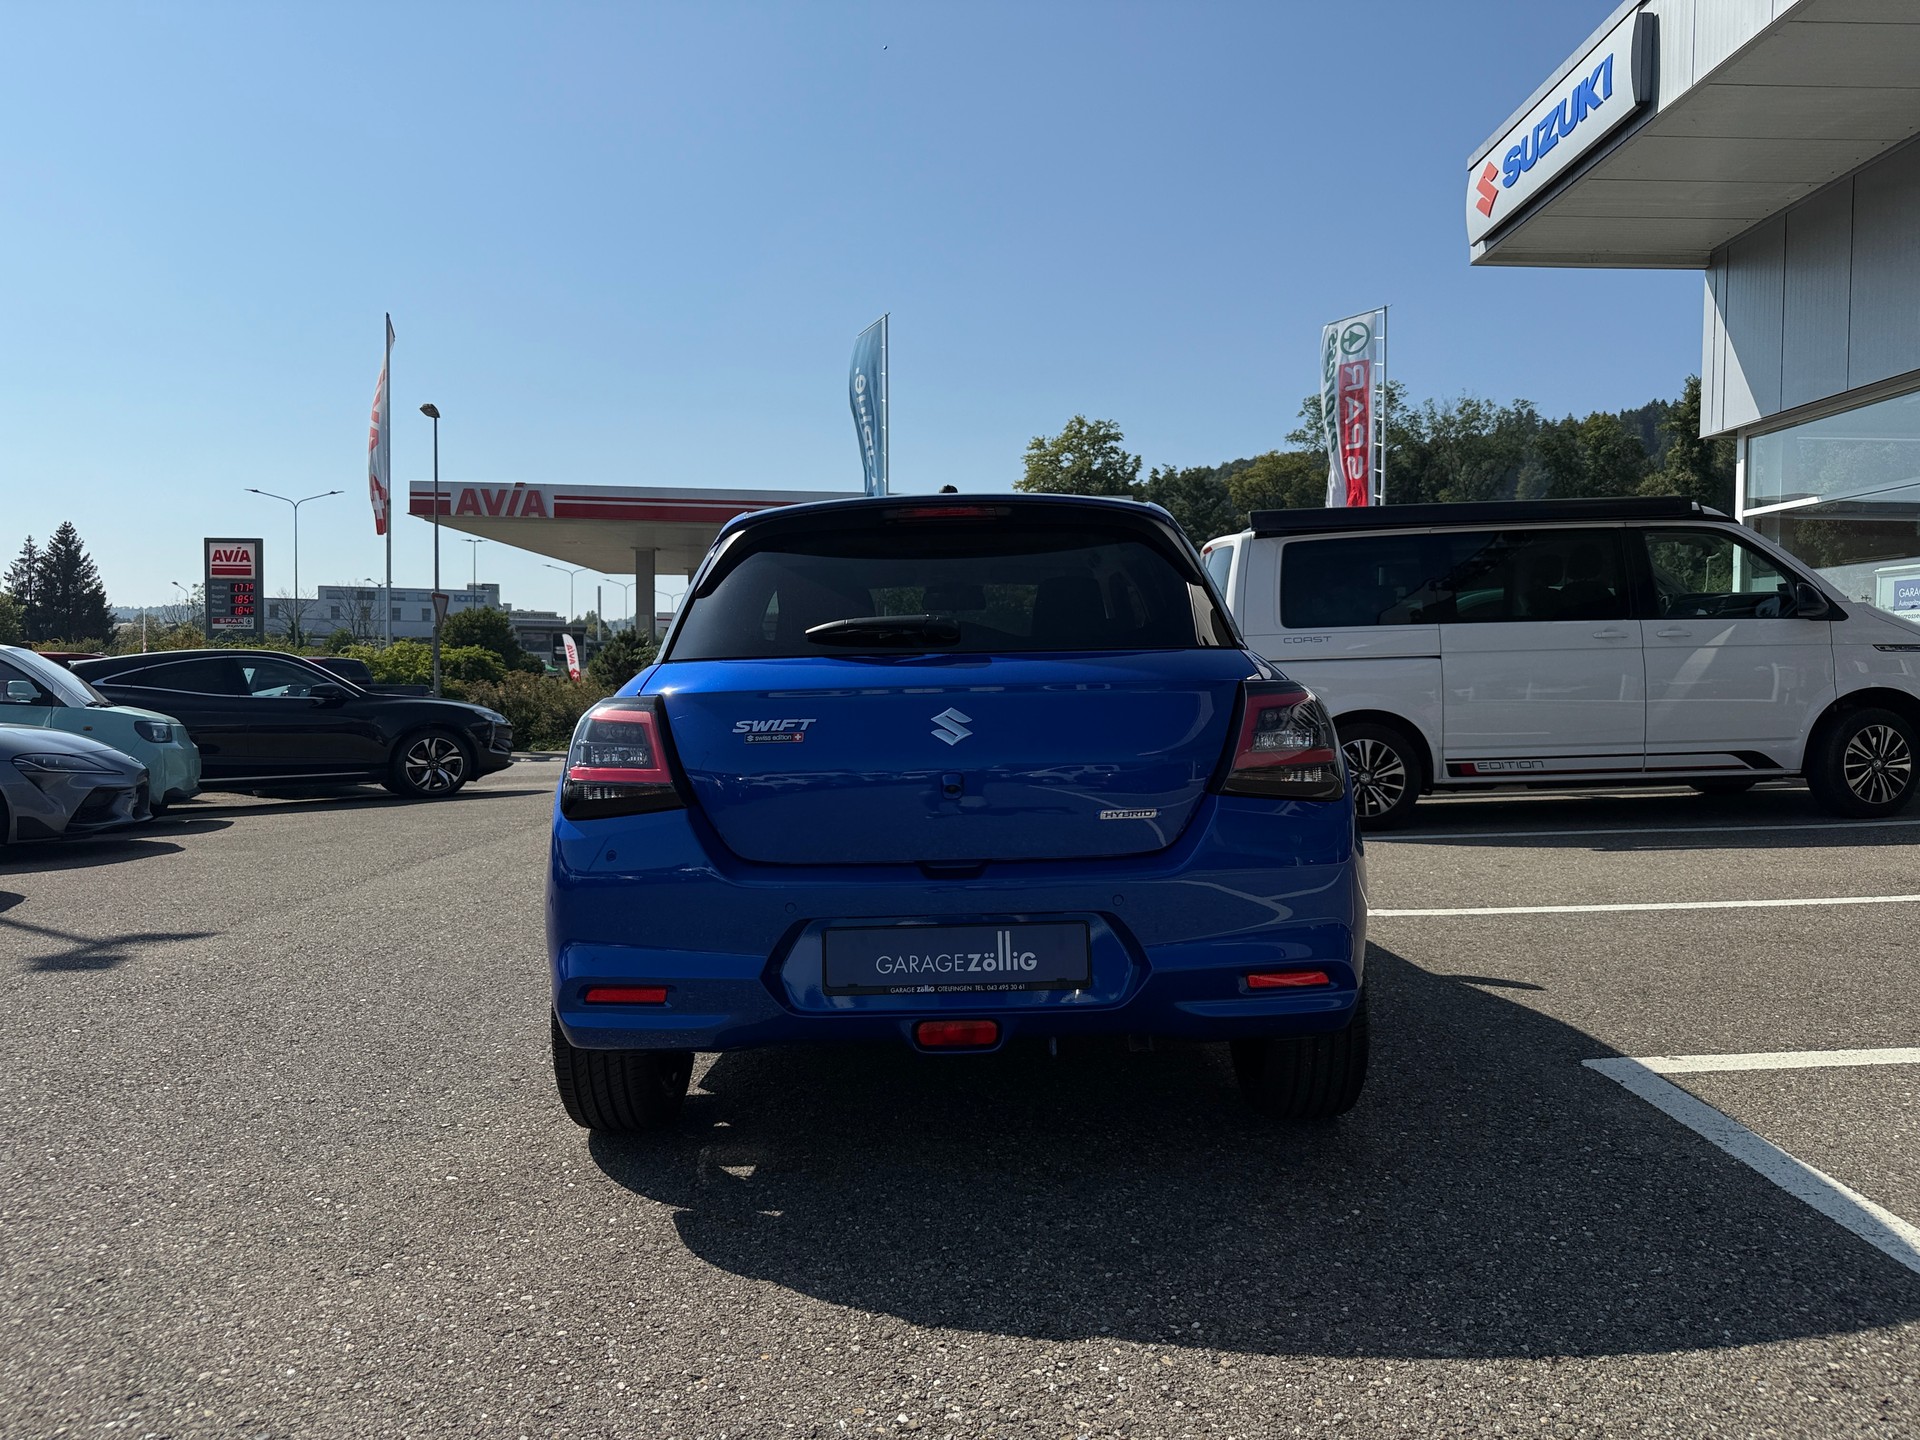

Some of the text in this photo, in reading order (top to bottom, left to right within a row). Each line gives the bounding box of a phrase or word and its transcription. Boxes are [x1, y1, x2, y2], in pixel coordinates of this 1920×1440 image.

[1502, 53, 1614, 189] SUZUKI
[1898, 587, 1920, 598] GARA
[1283, 635, 1332, 644] COAST
[732, 718, 817, 733] SWIFT
[1476, 760, 1545, 770] EDITION
[1103, 810, 1154, 818] HYBRID
[875, 954, 965, 974] GARAGE
[890, 986, 915, 994] GARAGE
[998, 983, 1009, 991] 495
